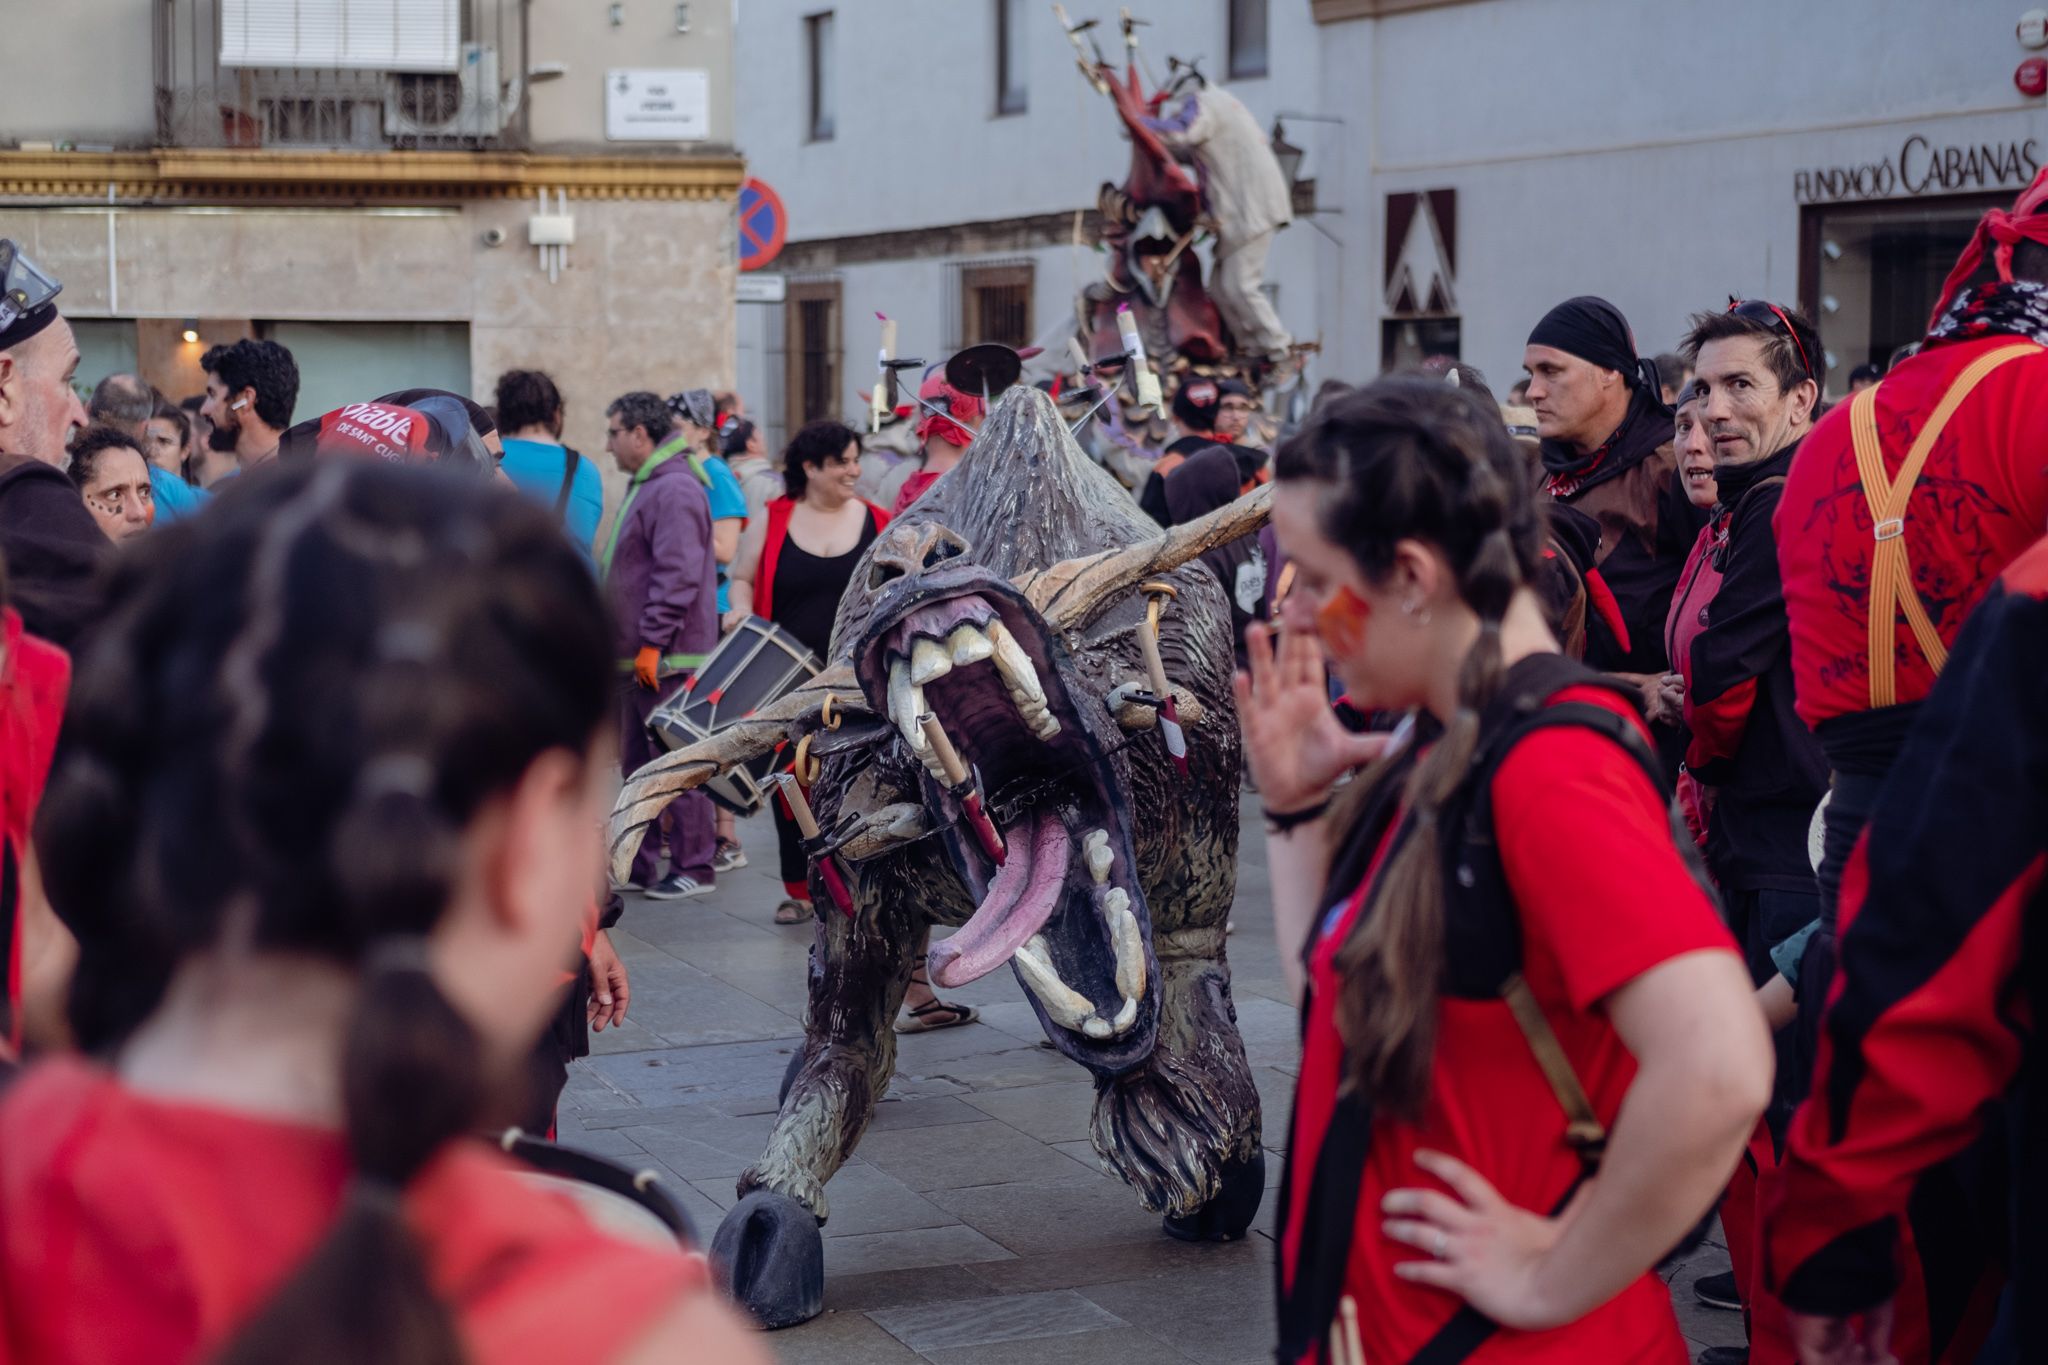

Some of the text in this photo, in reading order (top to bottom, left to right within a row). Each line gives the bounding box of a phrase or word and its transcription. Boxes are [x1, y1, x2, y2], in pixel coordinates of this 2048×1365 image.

[1794, 134, 2038, 204] FUNDACIÓ CABANAS
[336, 421, 404, 464] DE SANT CUG
[340, 402, 412, 446] Diable
